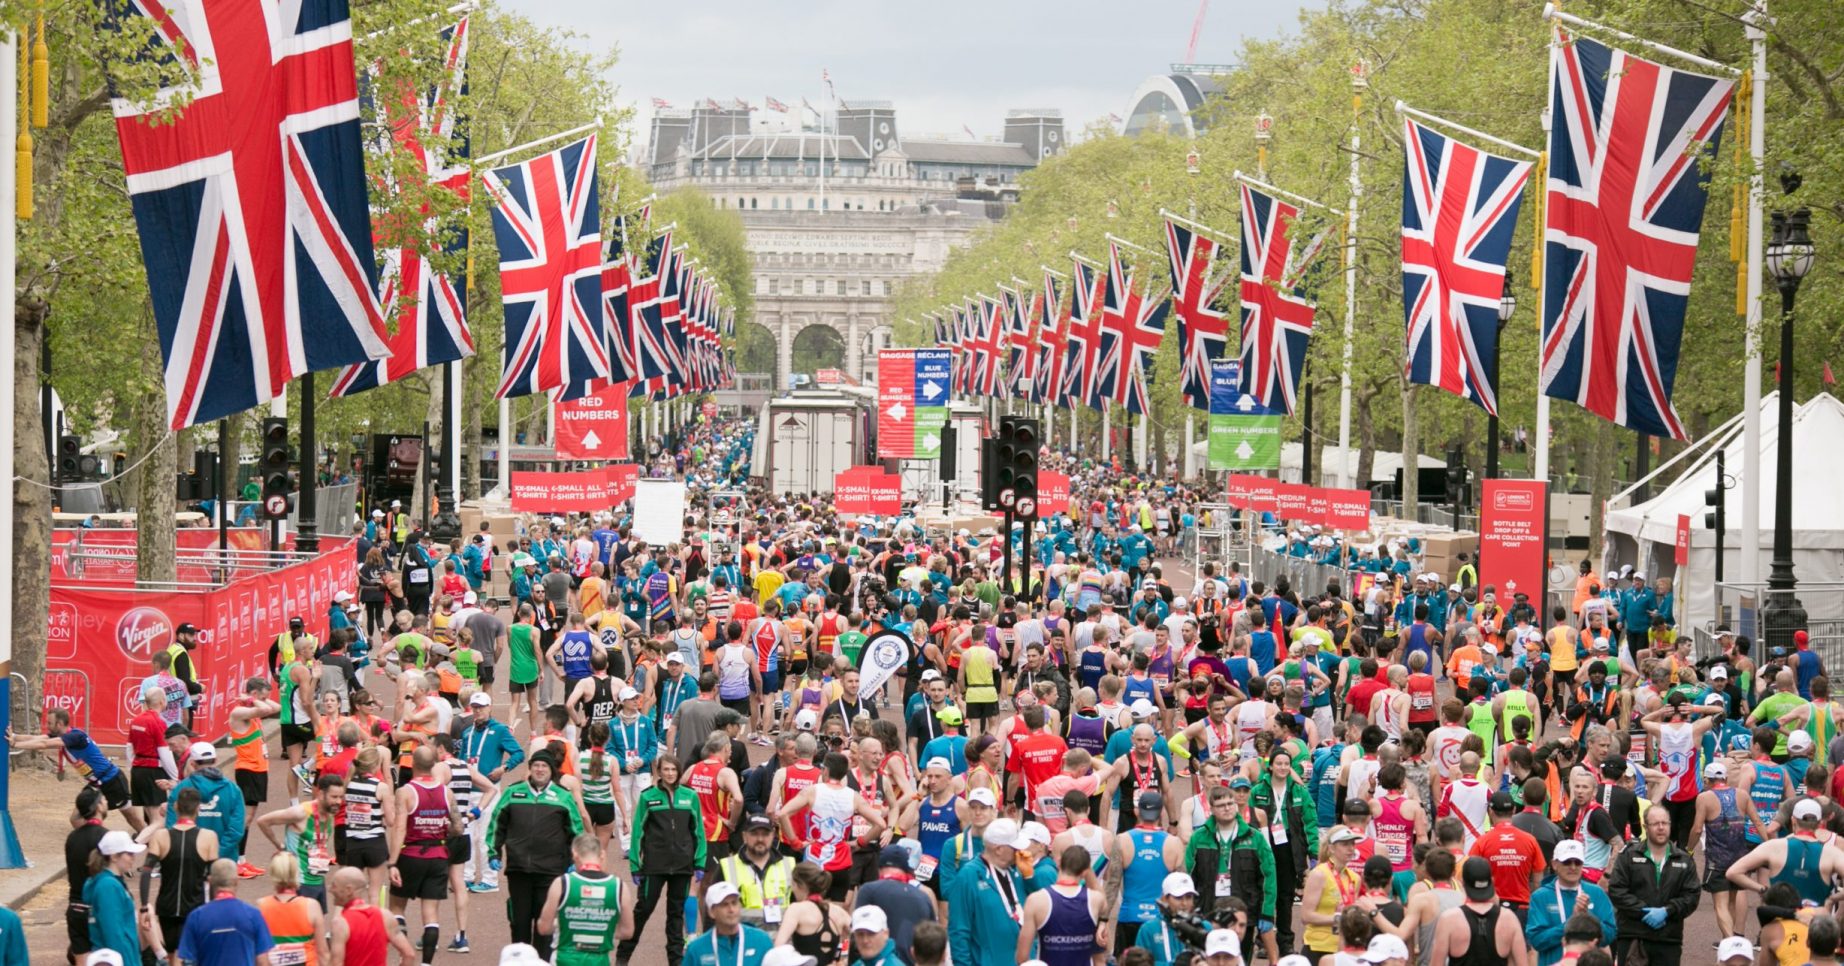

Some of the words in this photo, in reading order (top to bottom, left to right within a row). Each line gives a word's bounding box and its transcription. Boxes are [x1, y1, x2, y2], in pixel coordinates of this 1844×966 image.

[578, 397, 603, 407] RED
[562, 410, 619, 420] NUMBERS
[122, 614, 168, 654] Virgin
[594, 701, 614, 717] REP.
[414, 816, 451, 827] Tommy's
[1376, 822, 1406, 831] SHENLEY
[564, 906, 616, 916] MACMILLAN
[1043, 934, 1094, 944] CHICKENSHED
